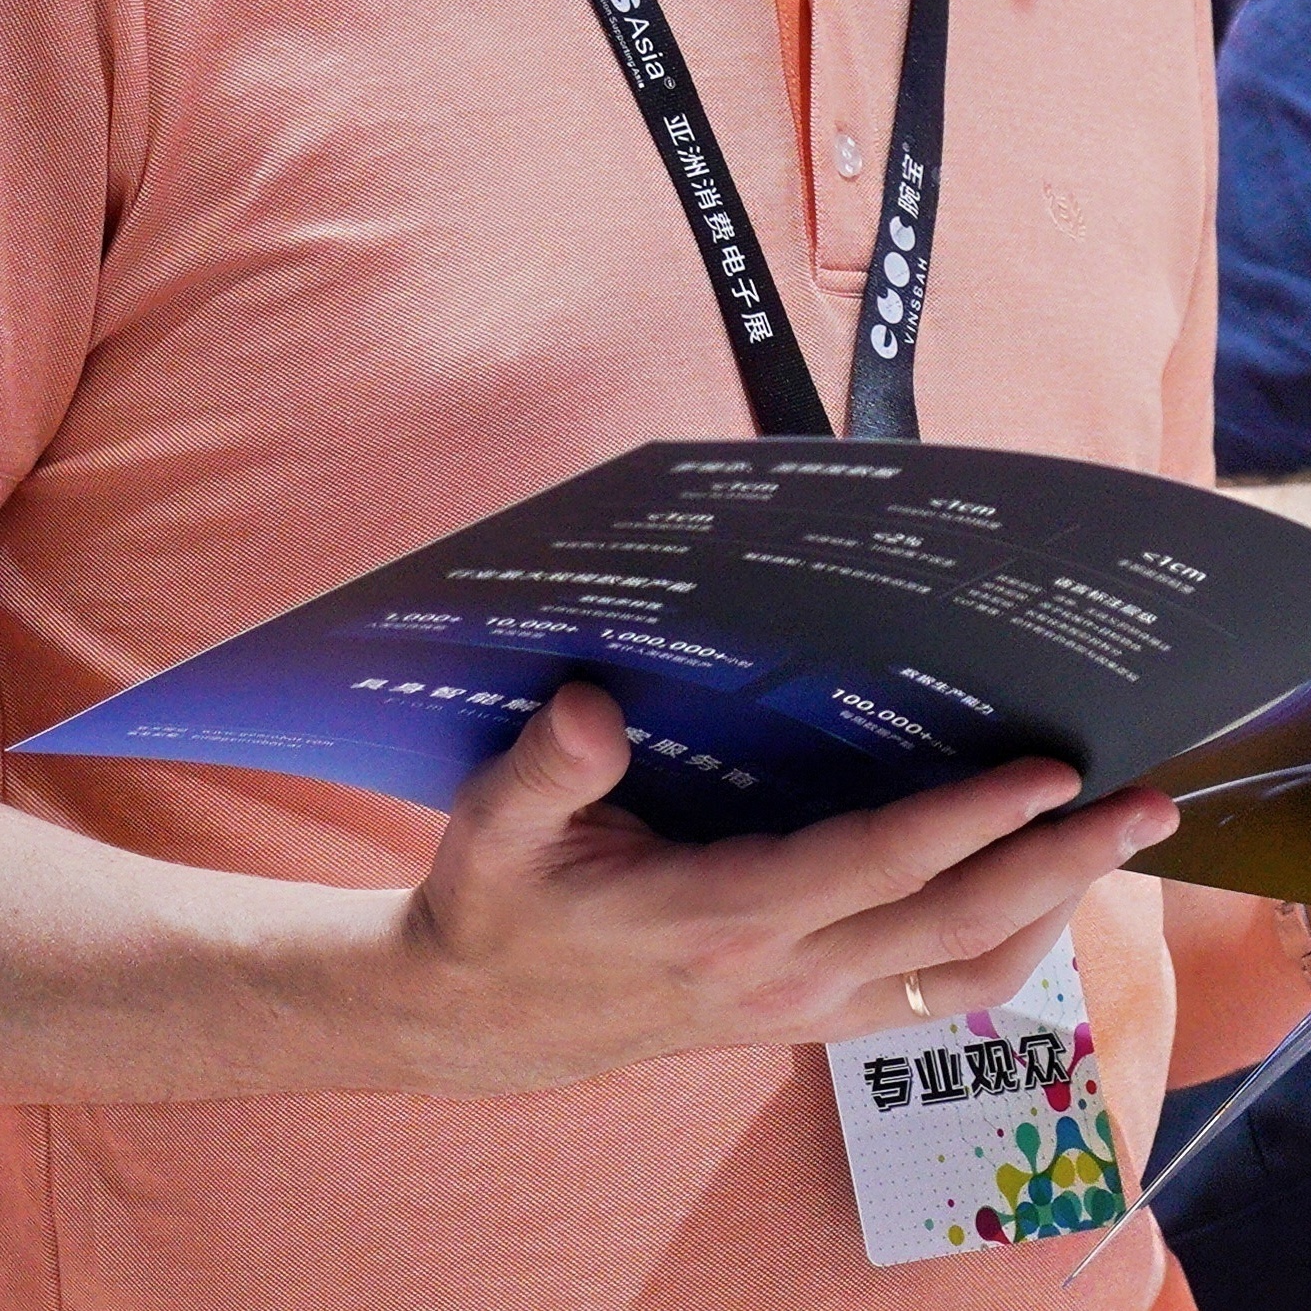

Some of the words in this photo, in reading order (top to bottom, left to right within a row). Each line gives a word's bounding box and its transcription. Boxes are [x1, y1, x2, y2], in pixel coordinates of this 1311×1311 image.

[623, 17, 666, 81] Asia
[662, 111, 775, 345] 亚洲消费电子展
[904, 258, 928, 346] VINSBAH
[1141, 550, 1207, 583] <1cm
[485, 615, 579, 634] 10,000+
[862, 1031, 1071, 1112] 专业观众
